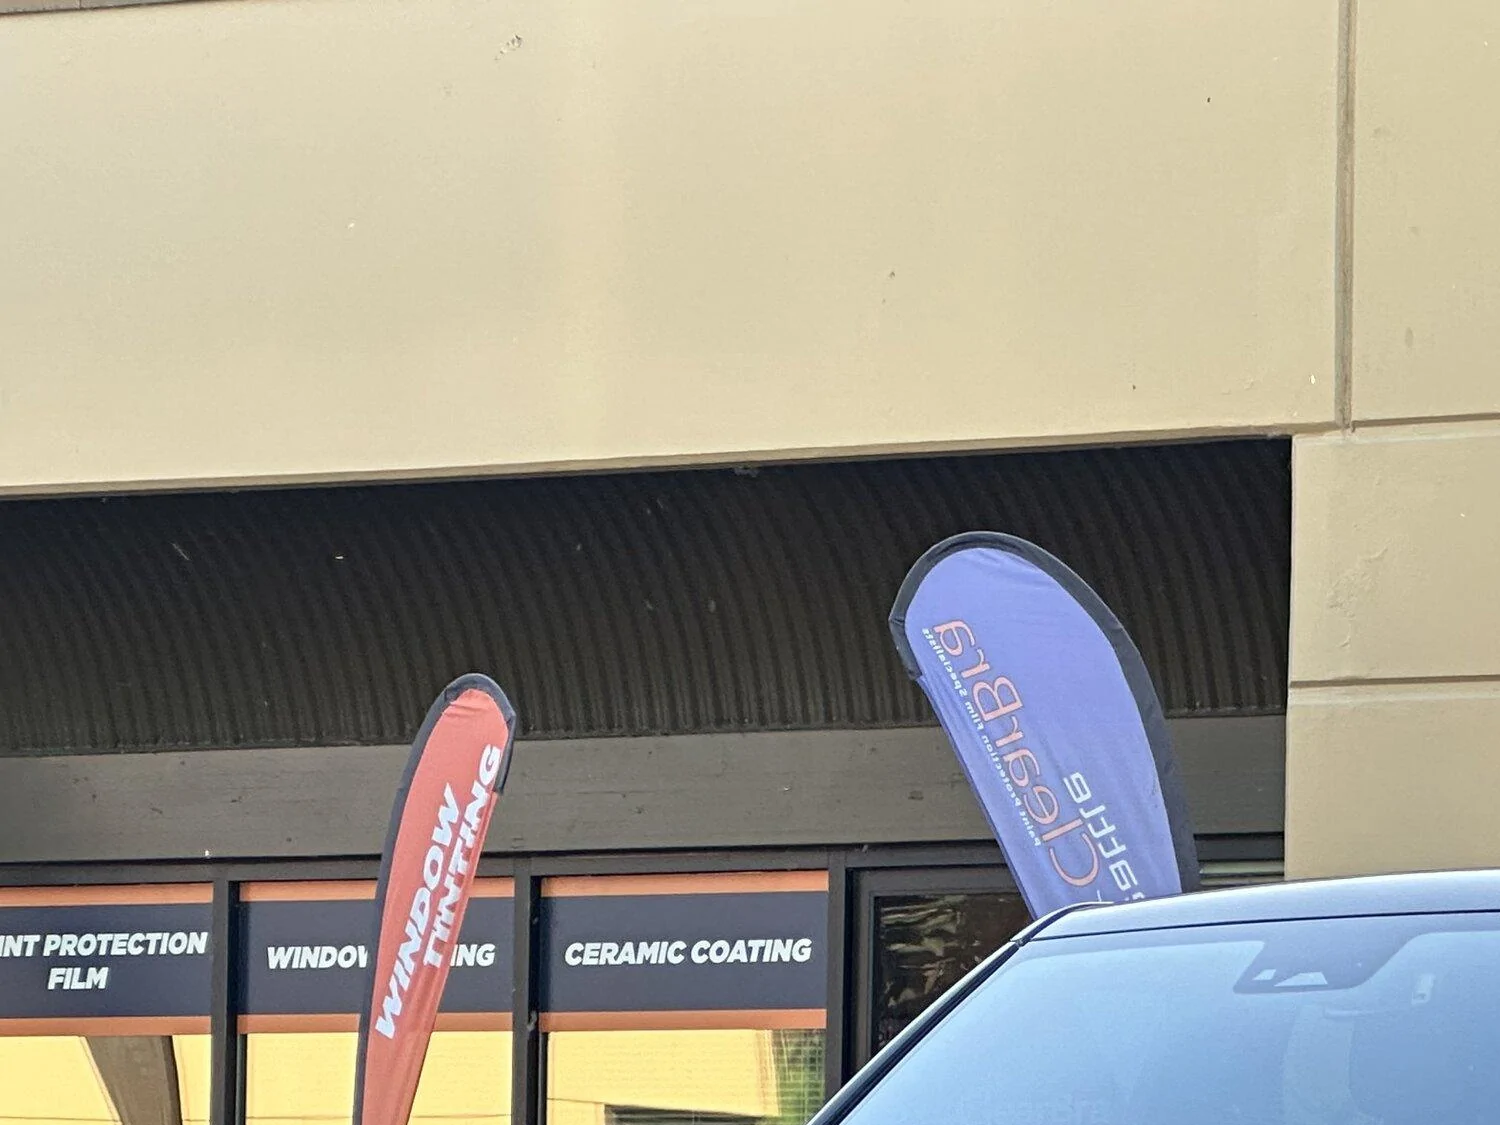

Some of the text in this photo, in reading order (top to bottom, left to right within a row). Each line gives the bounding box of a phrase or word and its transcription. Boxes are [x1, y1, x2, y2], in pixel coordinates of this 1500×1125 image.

[422, 743, 502, 968] TINTING
[374, 782, 460, 1040] WINDOW
[0, 931, 209, 957] INT PROTECTION
[564, 937, 812, 966] CERAMIC COATING
[47, 966, 109, 990] FILM
